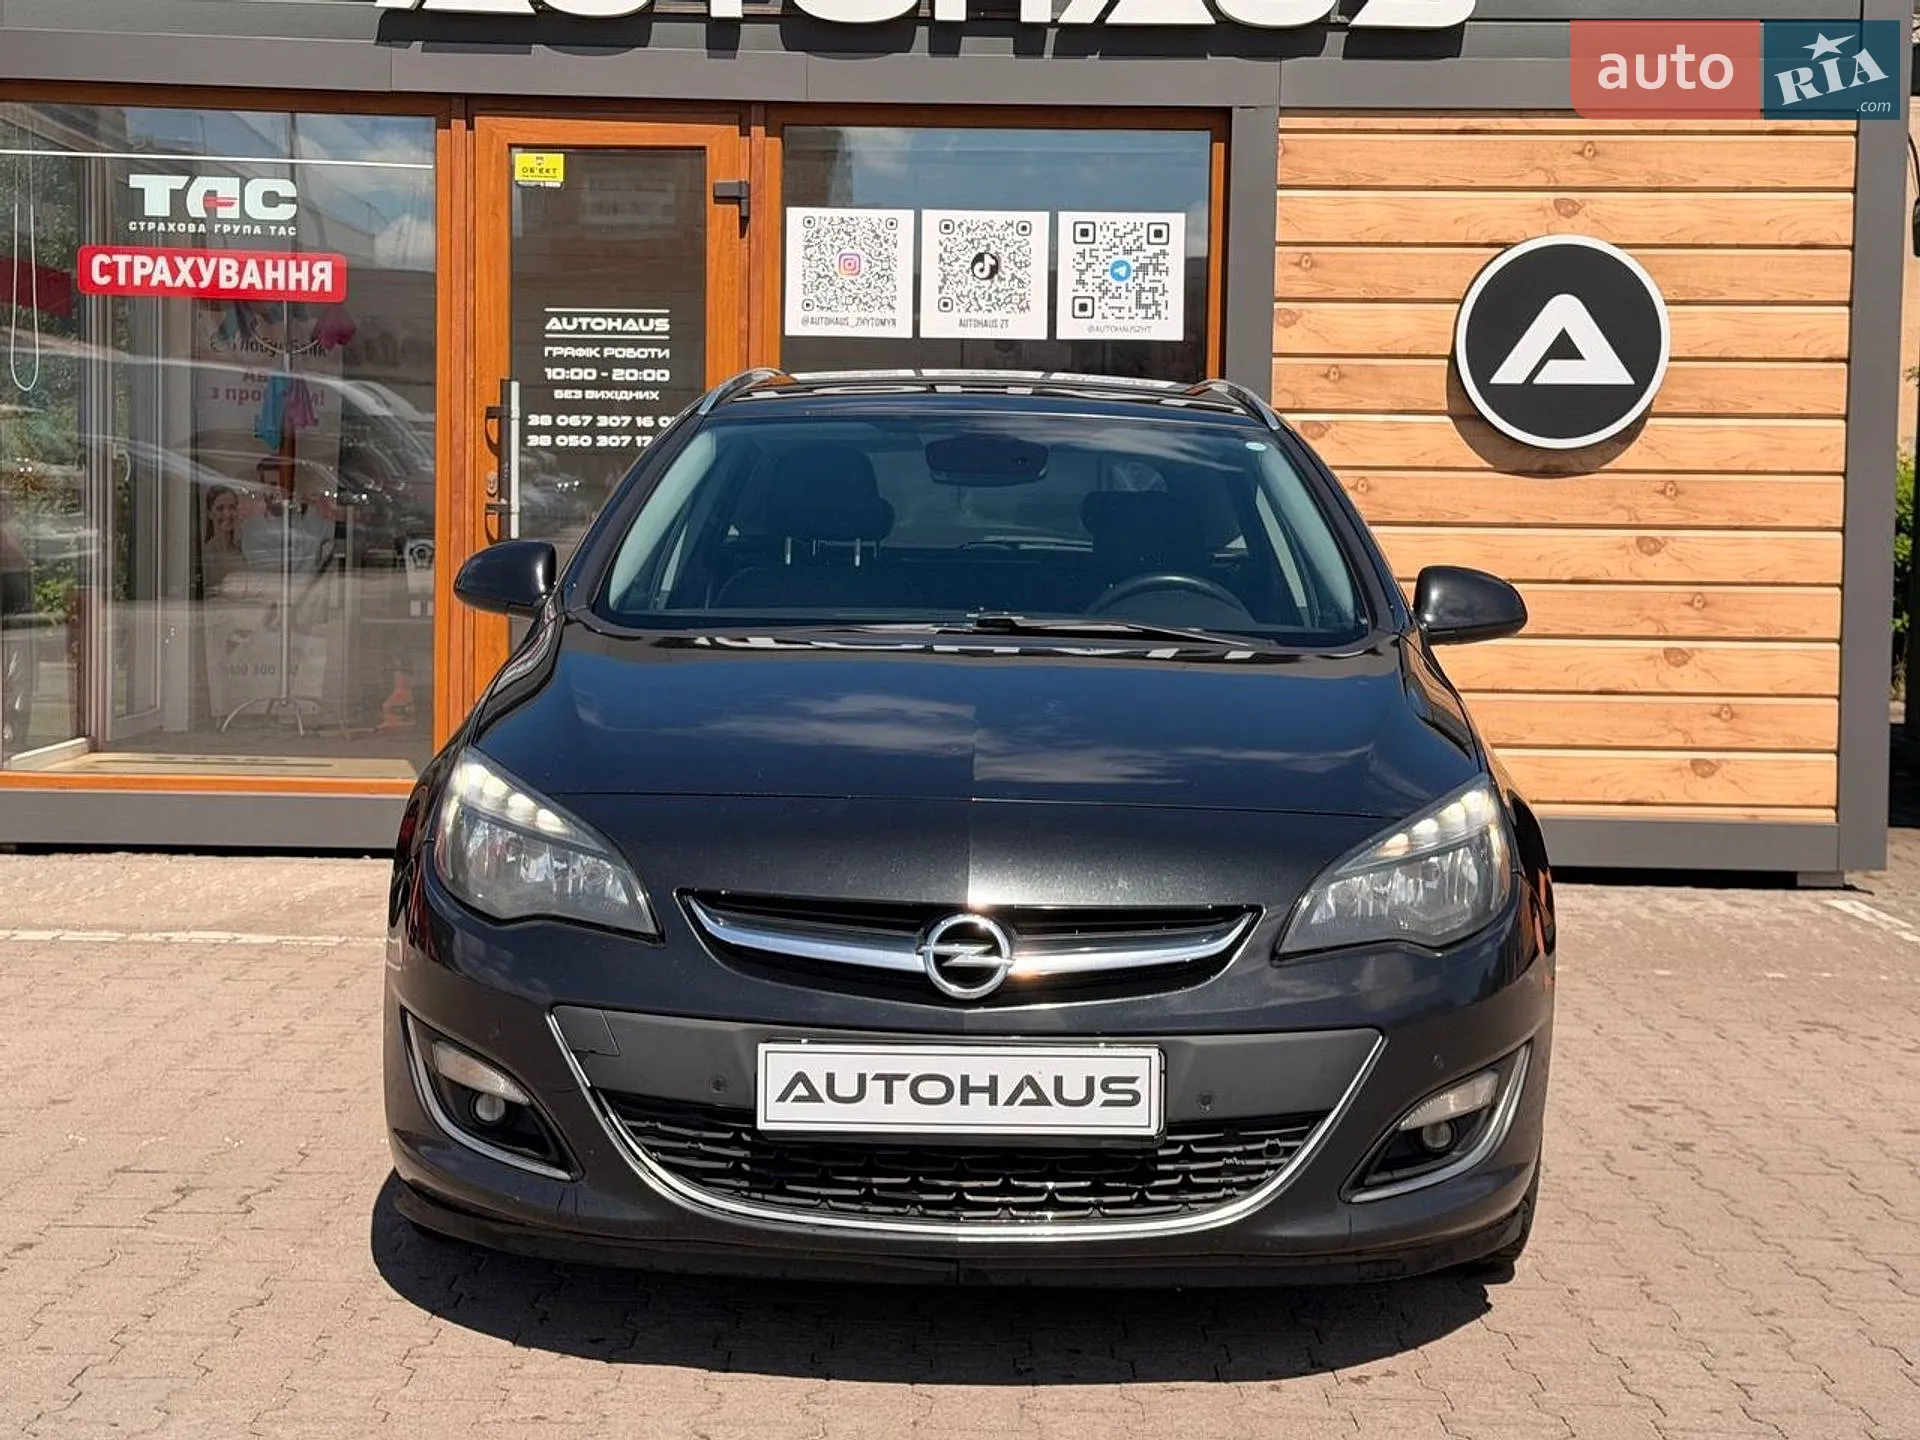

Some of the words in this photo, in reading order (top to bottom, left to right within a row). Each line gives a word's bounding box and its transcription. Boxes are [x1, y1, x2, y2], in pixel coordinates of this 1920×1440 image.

[128, 221, 207, 234] СТРАХОВА
[213, 223, 262, 236] ГРУПА
[268, 225, 298, 236] ТАС
[91, 253, 333, 293] СТРАХУВАННЯ
[545, 317, 671, 331] AUTOHAUS
[959, 318, 998, 328] AUTOHAUS
[544, 346, 601, 358] ГРАФІК
[603, 347, 671, 359] РОБОТИ
[544, 367, 598, 380] 10:00
[612, 368, 671, 381] 20:00
[553, 389, 583, 399] БЕЗ
[585, 390, 660, 401] ВИХІДНИХ
[527, 414, 552, 427] 38
[556, 415, 593, 427] 067
[596, 415, 632, 427] 307
[635, 416, 655, 427] 16
[526, 434, 552, 447] 38
[555, 434, 593, 447] 050
[596, 435, 632, 448] 307
[775, 1071, 1142, 1107] AUTOHAUS
